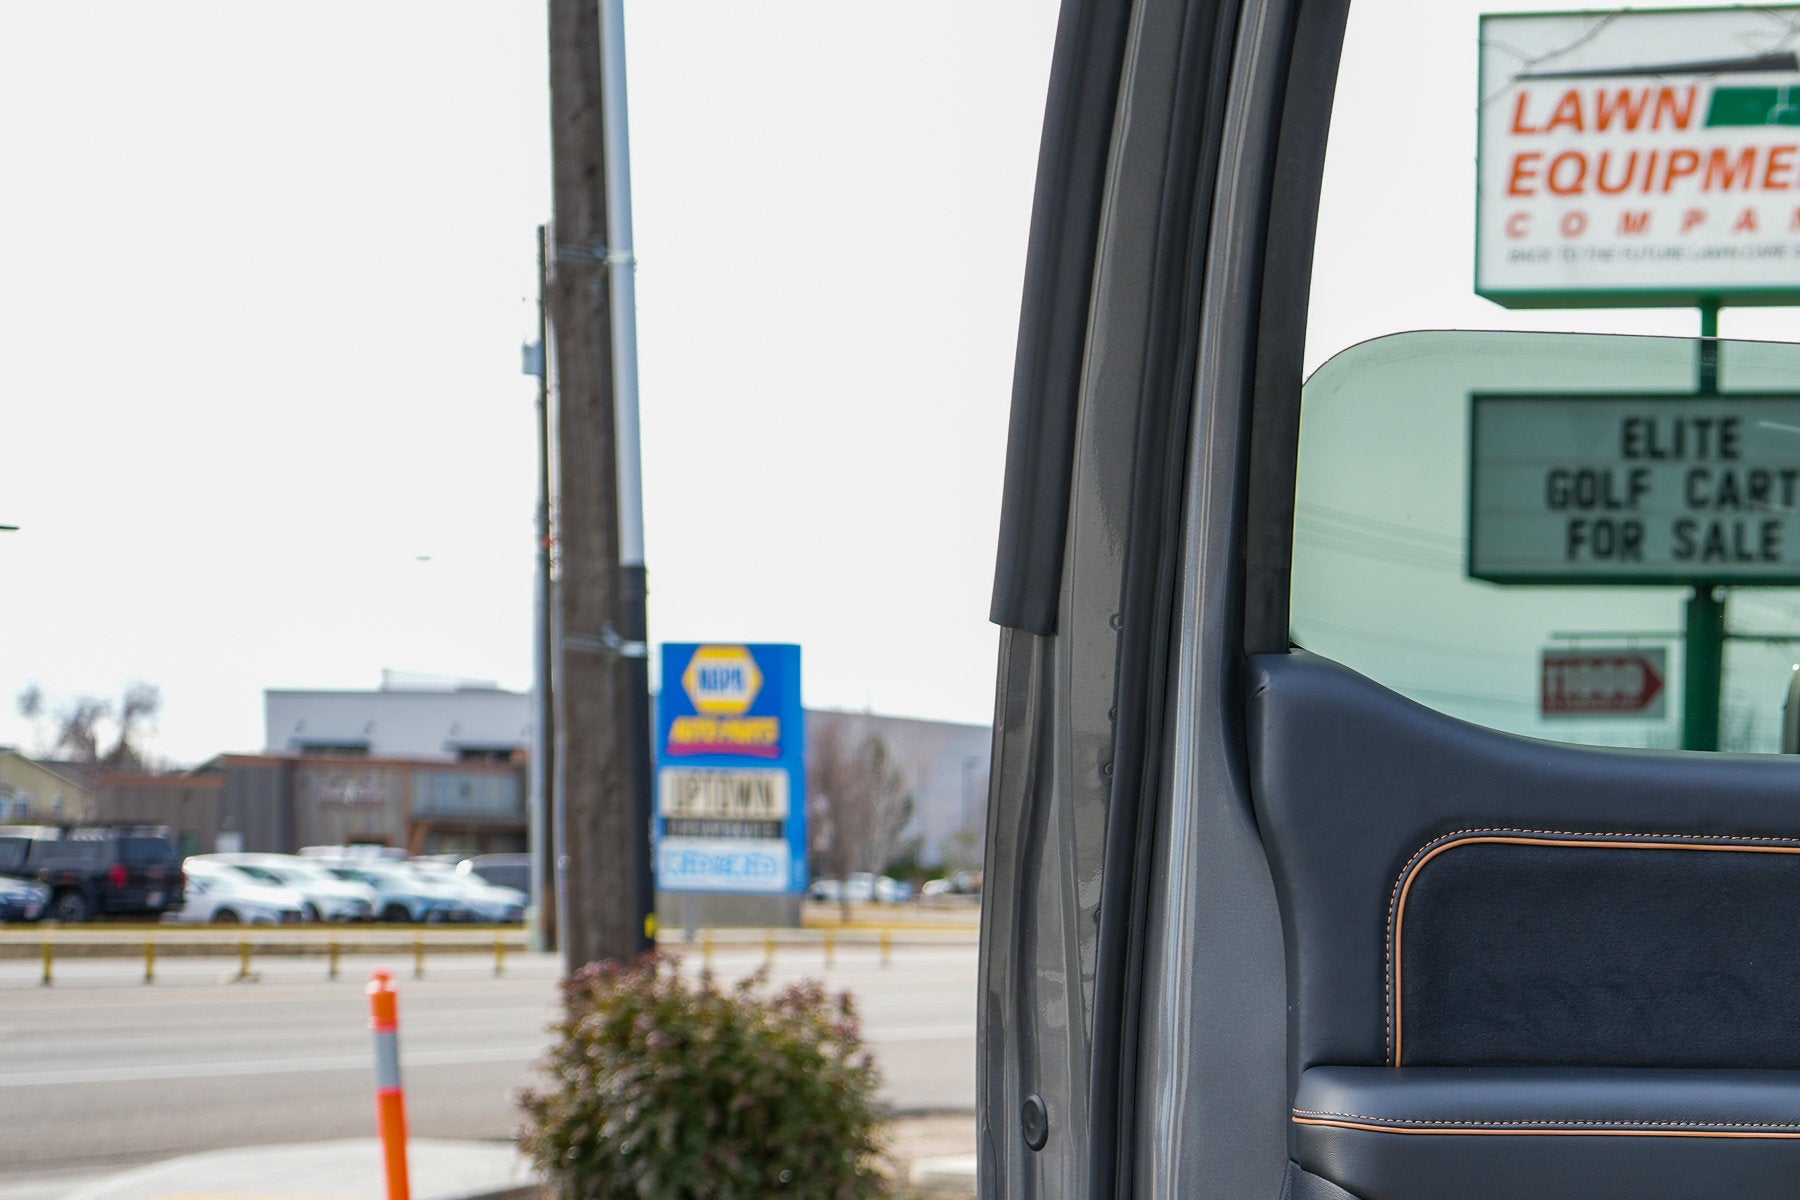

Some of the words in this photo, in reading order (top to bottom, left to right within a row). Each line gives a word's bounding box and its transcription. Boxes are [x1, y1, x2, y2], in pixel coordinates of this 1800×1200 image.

[1509, 84, 1697, 136] LAWN
[1620, 414, 1743, 461] ELITE
[1545, 468, 1652, 513] GOLF
[1566, 518, 1646, 562] FOR
[1672, 518, 1784, 563] SALE
[699, 667, 745, 691] NAPA
